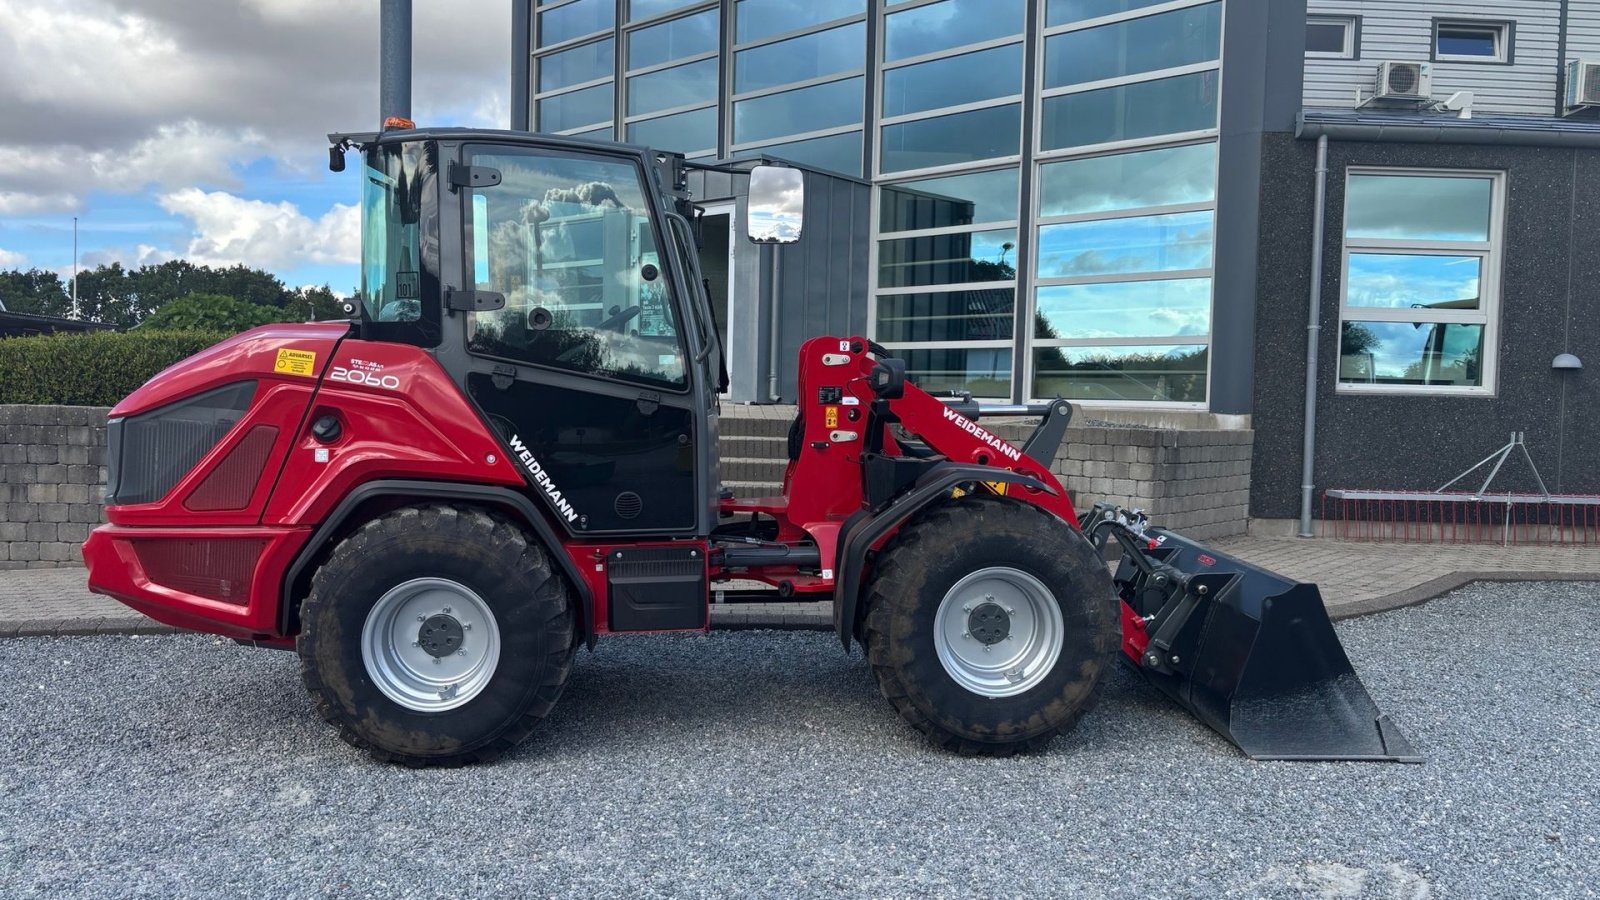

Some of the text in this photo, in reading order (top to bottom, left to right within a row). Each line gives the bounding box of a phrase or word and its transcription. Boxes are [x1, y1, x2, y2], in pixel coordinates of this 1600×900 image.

[330, 366, 400, 389] 2060
[943, 406, 1021, 462] WEIDEMANN
[509, 434, 578, 522] WEIDEMANN
